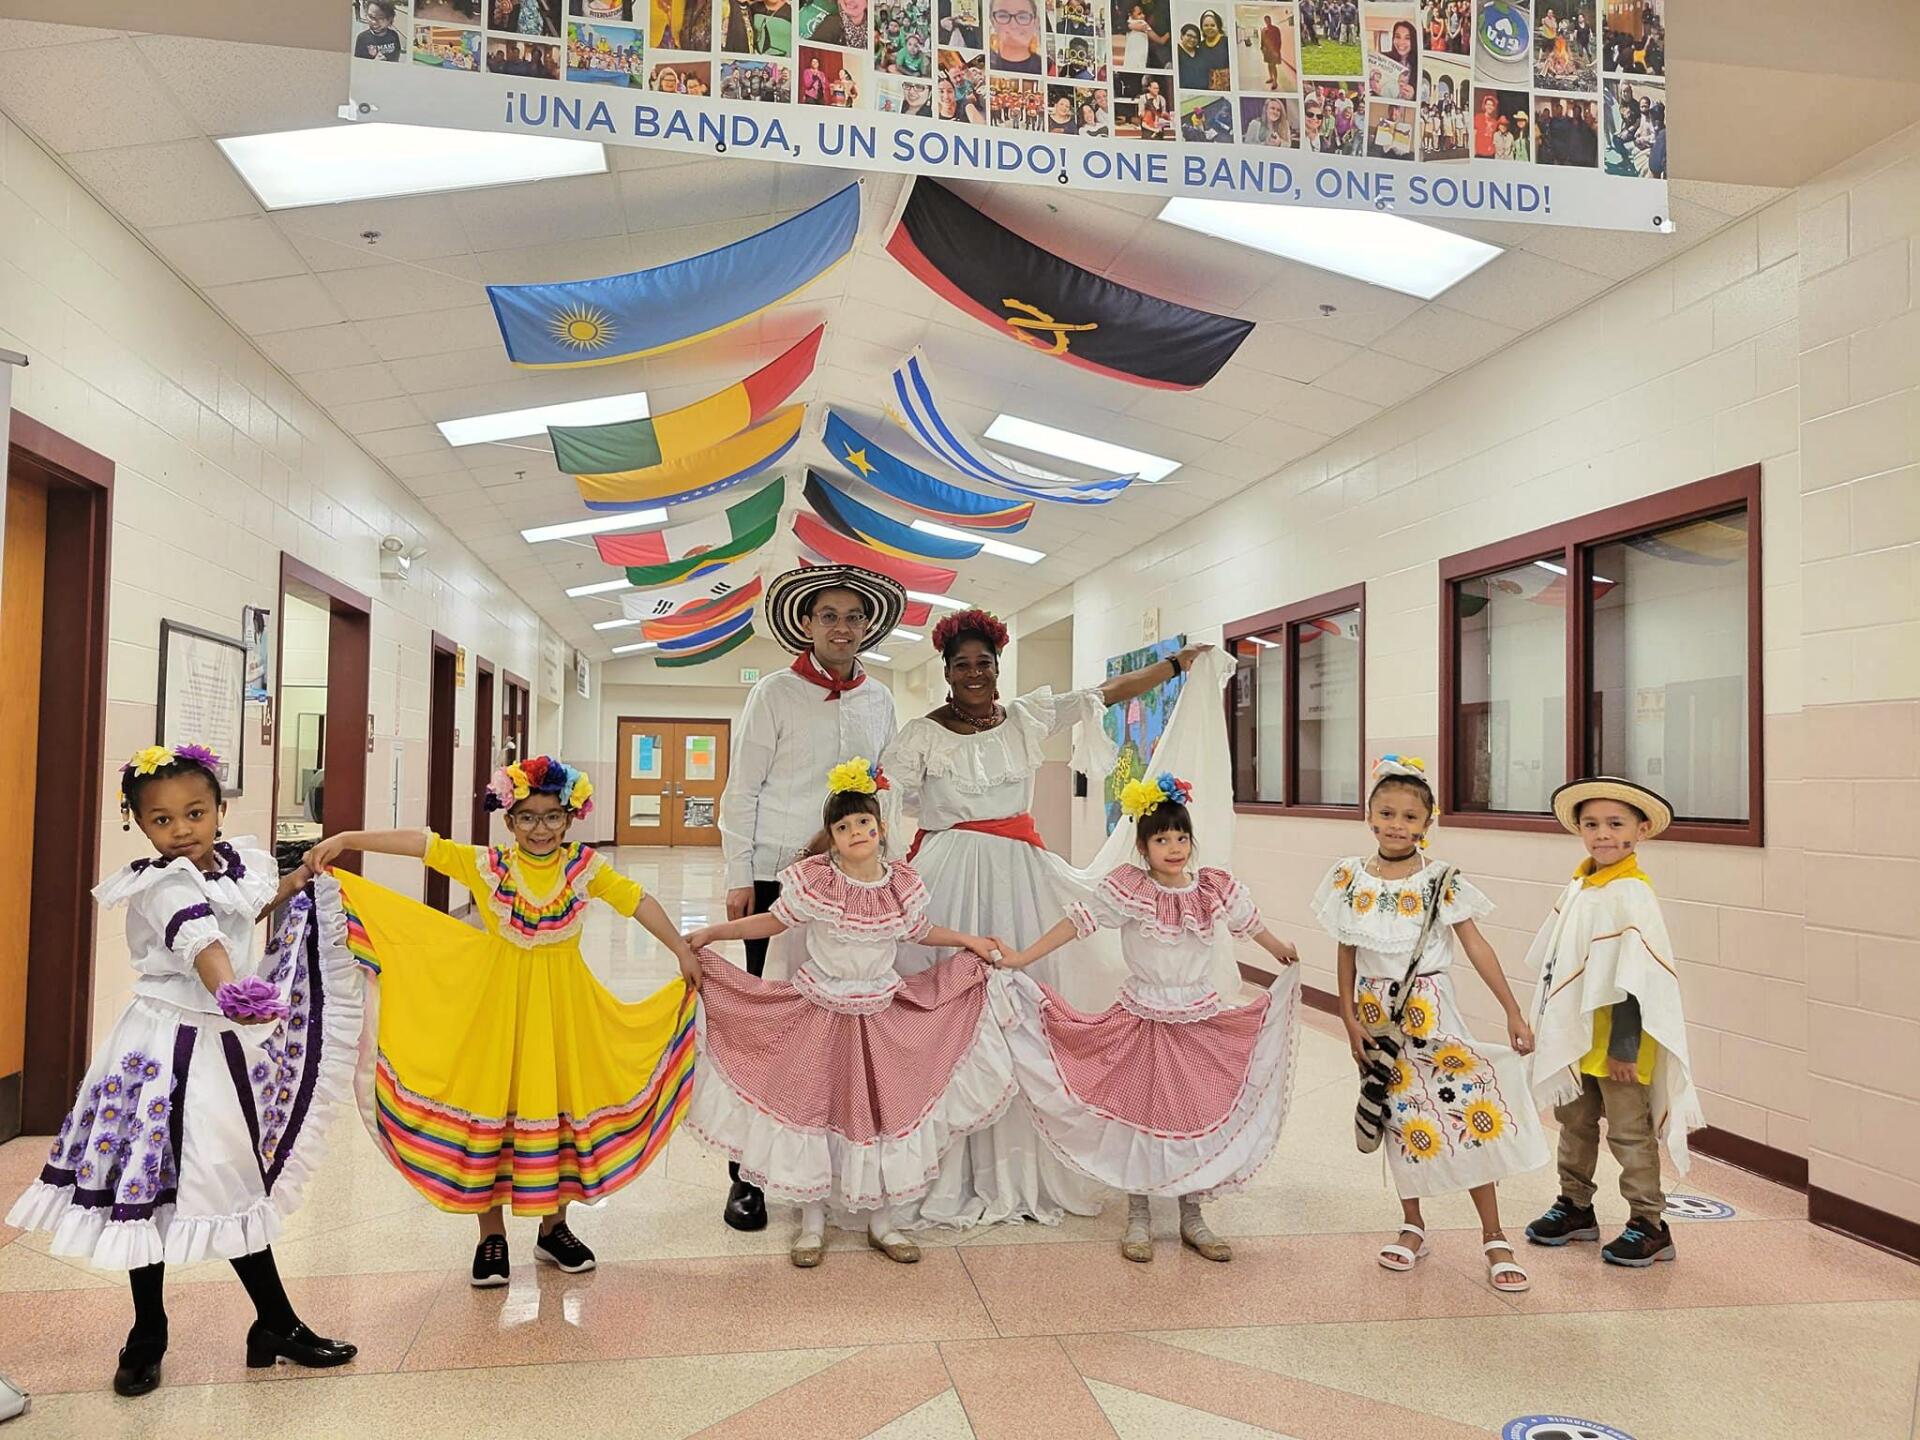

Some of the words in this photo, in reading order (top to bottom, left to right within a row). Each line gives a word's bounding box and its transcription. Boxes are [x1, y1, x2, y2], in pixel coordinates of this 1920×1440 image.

[505, 91, 616, 134] ¡UNA
[634, 105, 801, 157] BANDA,
[818, 122, 876, 159] UN
[892, 129, 1067, 177] SONIDO!
[1083, 150, 1169, 184] ONE
[1184, 156, 1301, 200] BAND,
[1315, 168, 1395, 202] ONE
[1409, 176, 1551, 213] SOUND!
